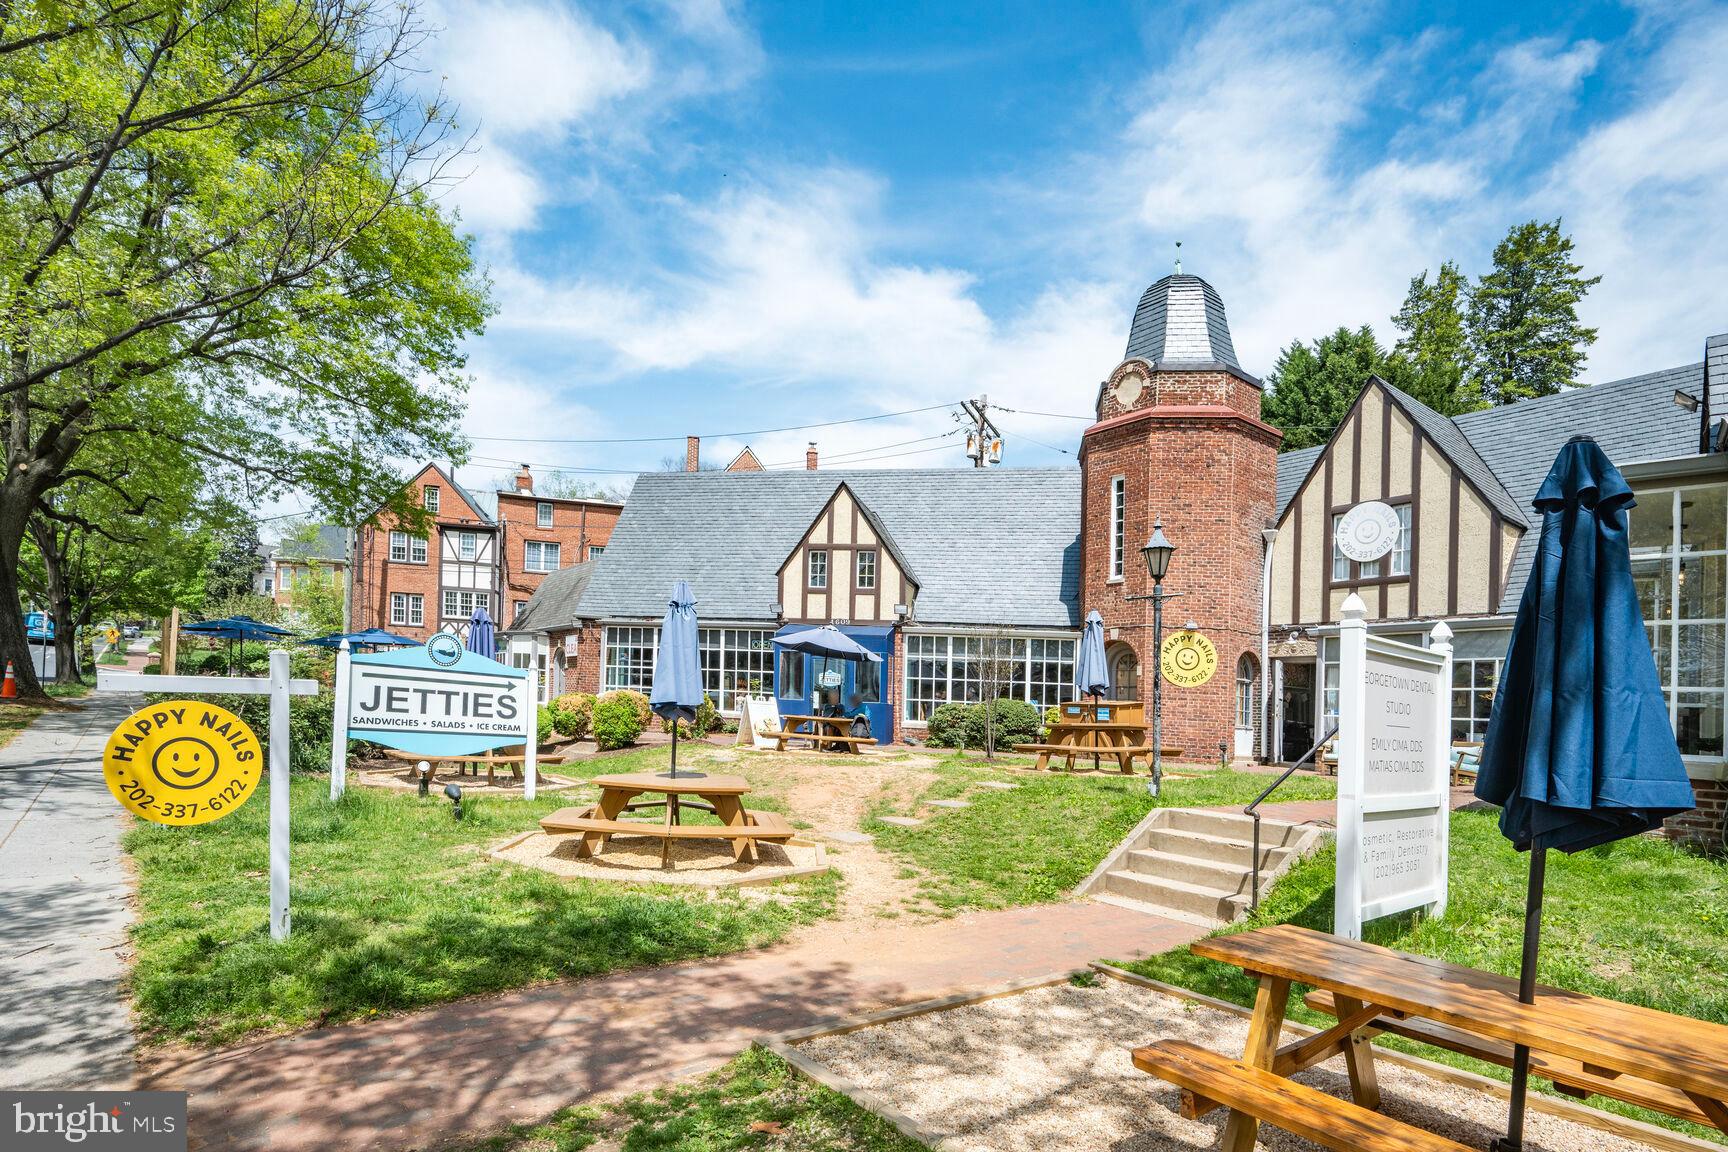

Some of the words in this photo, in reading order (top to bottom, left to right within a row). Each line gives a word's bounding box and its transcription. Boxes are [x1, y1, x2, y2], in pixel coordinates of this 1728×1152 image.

[1342, 536, 1393, 558] 202-337-6122
[1163, 635, 1193, 654] HAPPY
[1196, 638, 1214, 664] NAILS
[1163, 662, 1208, 683] 202-337-6122
[1410, 679, 1435, 695] DENTAL
[359, 685, 518, 720] JETTIES
[1385, 700, 1411, 715] STUDIO
[352, 716, 419, 727] SANDWICHES
[431, 720, 466, 729] SALADS
[476, 722, 490, 731] ICE
[492, 723, 521, 732] CREAM
[112, 708, 187, 762] HAPPY
[199, 711, 255, 762] NAILS
[1372, 737, 1391, 751] EMILY
[1410, 740, 1423, 752] DDS
[1368, 760, 1393, 773] MATIAS
[1411, 760, 1425, 773] DDS
[119, 779, 247, 819] 202-337-6122
[1397, 828, 1434, 841] Restorative
[1371, 848, 1395, 861] Family
[1398, 844, 1429, 858] Dentistry
[1406, 858, 1420, 872] 3051
